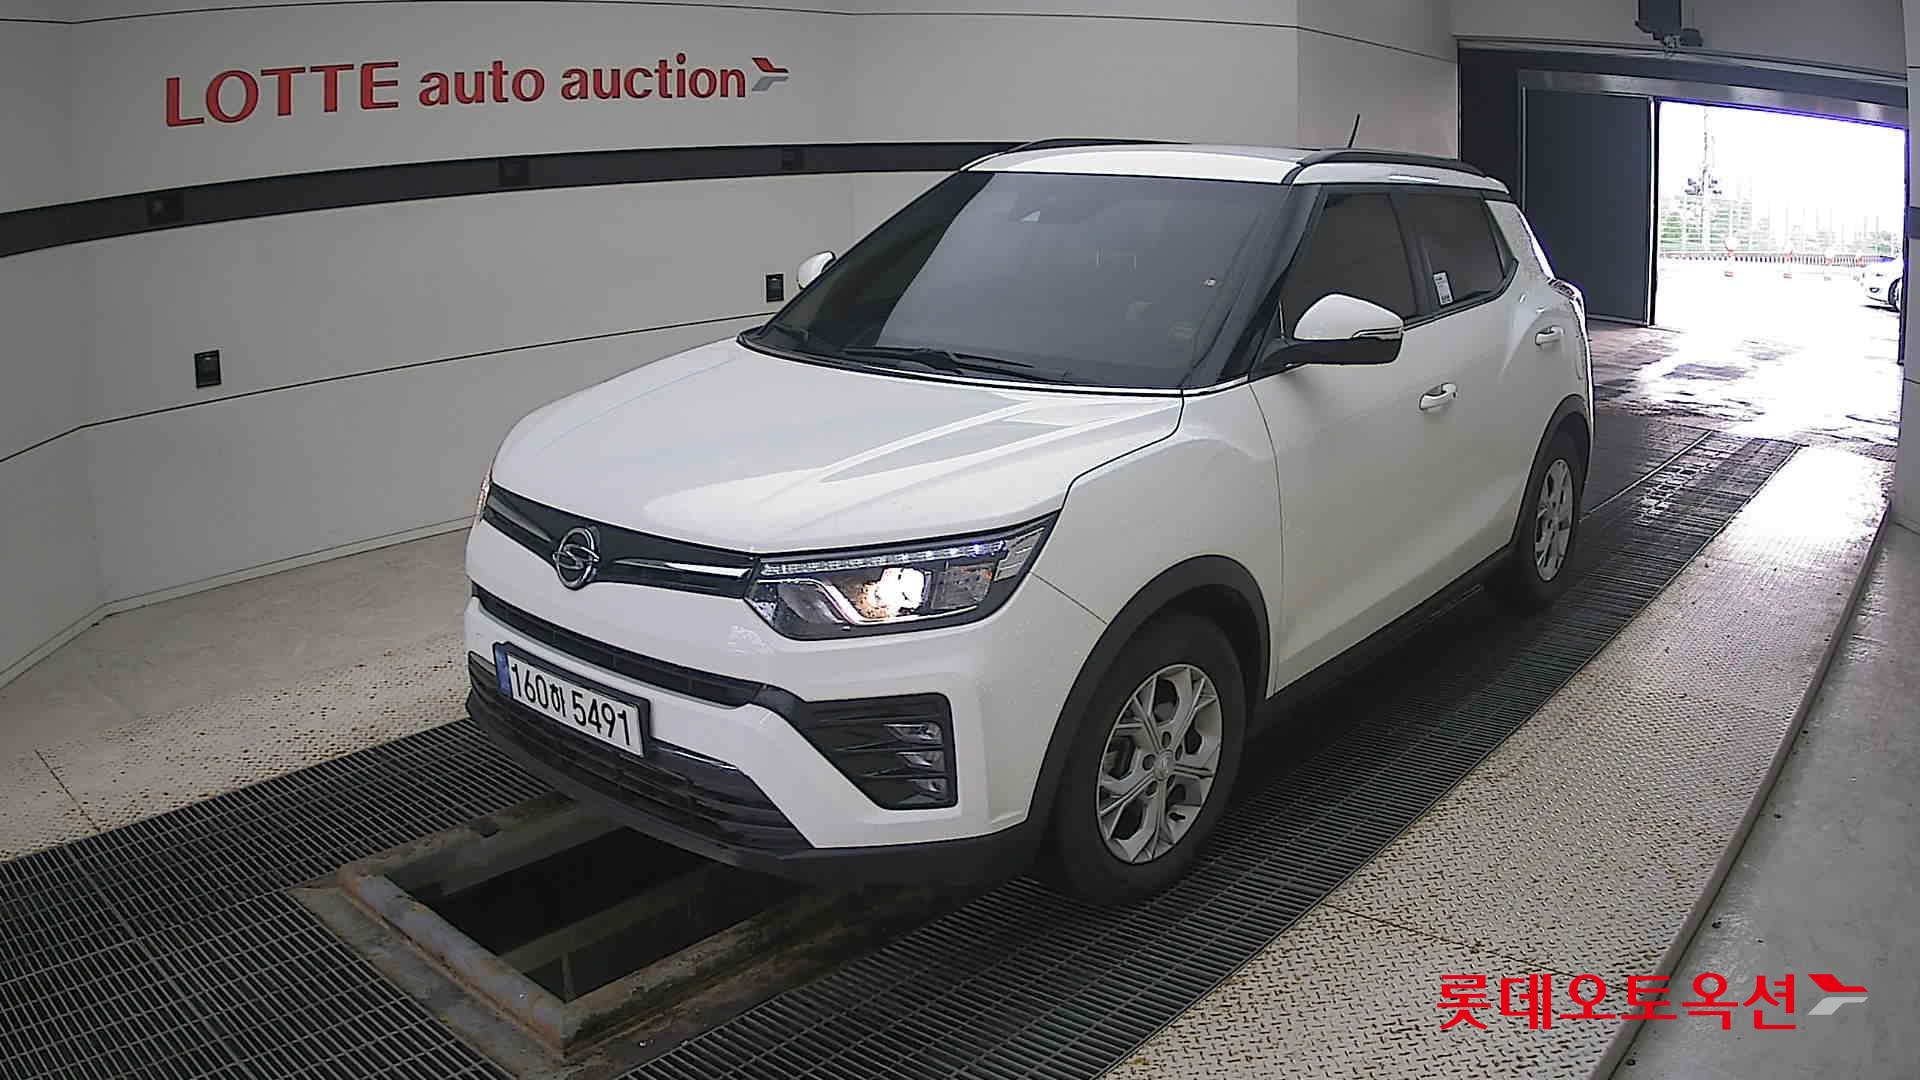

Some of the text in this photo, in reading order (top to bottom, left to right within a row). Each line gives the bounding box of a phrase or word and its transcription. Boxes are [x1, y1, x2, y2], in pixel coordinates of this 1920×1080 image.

[165, 53, 746, 127] LOTTE auto auction
[571, 690, 631, 746] 5491
